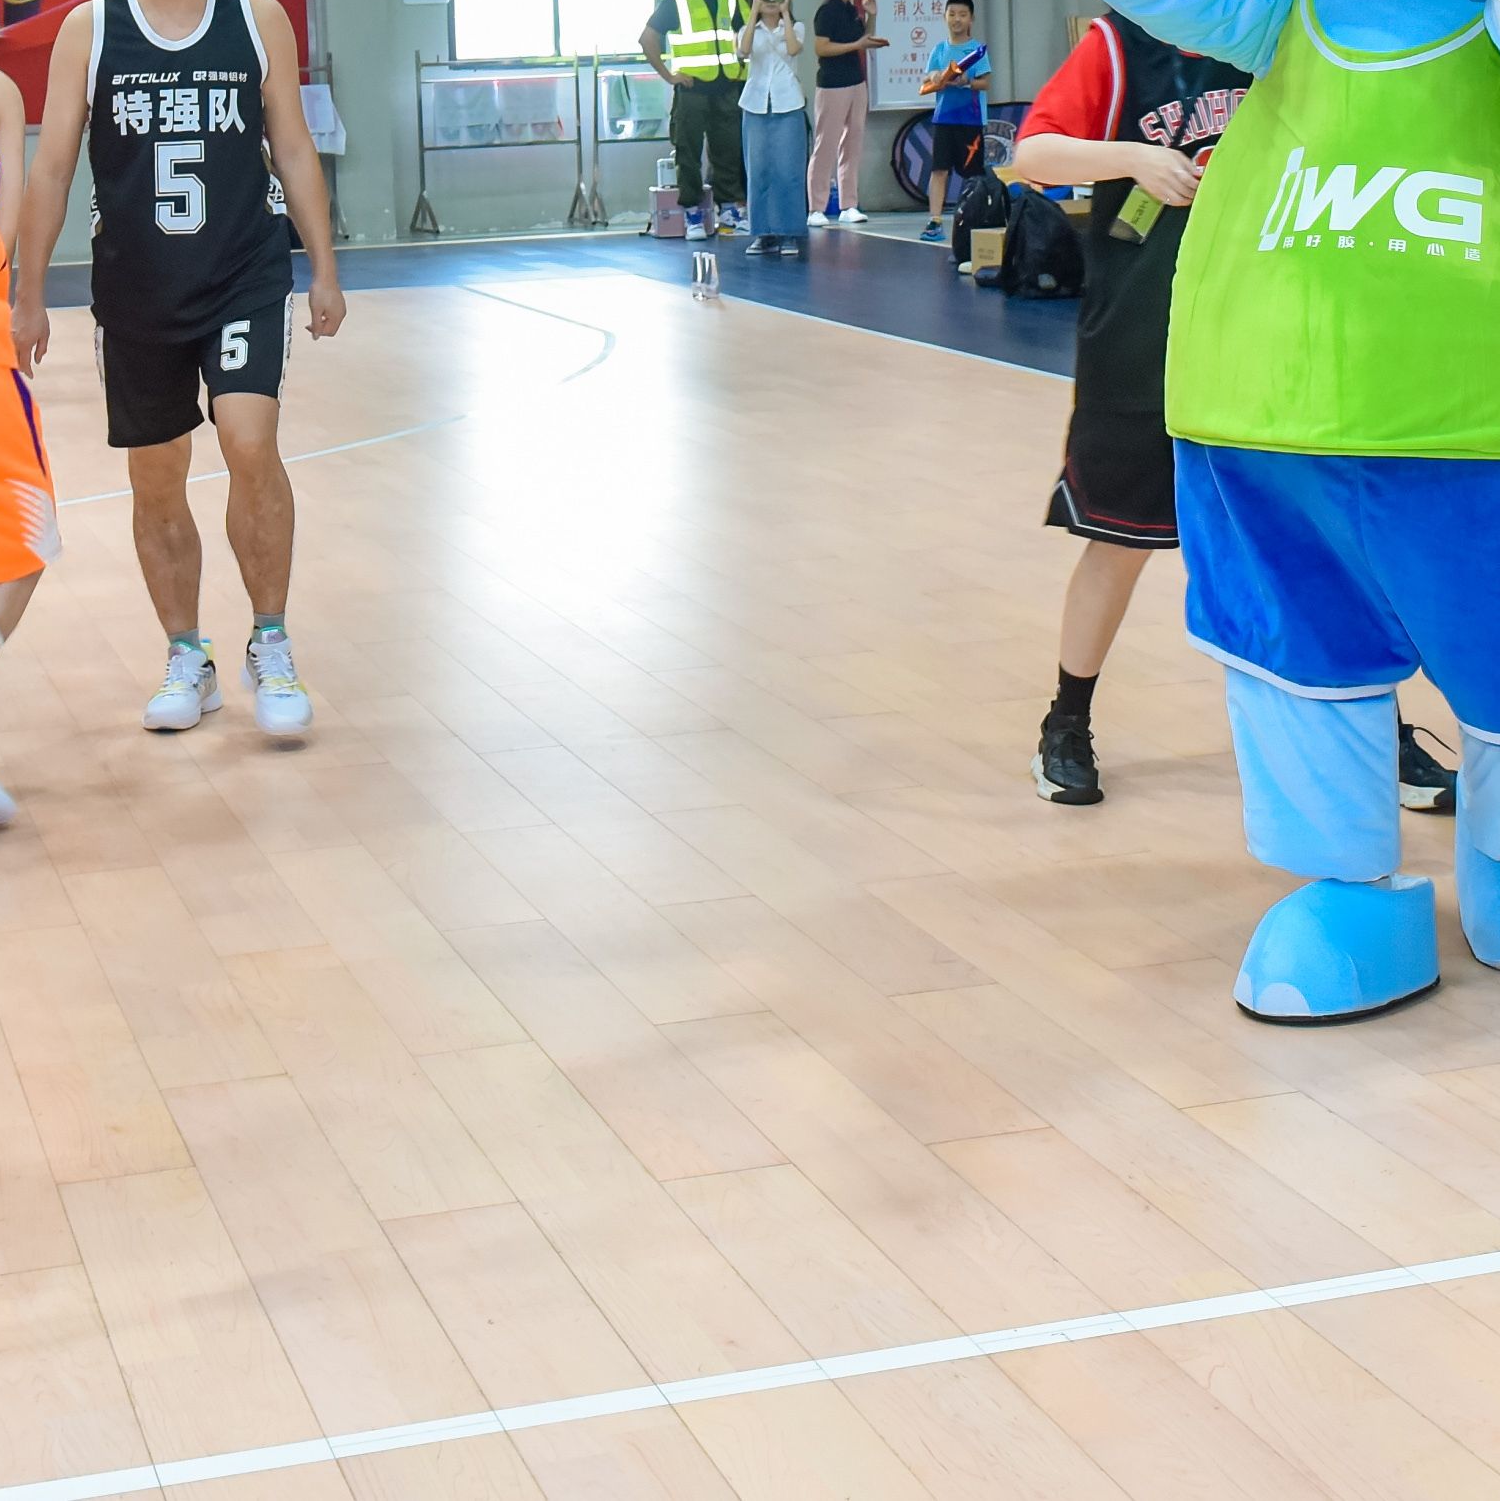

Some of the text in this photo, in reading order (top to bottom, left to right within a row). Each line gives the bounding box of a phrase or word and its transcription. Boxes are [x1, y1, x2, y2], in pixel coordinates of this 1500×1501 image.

[893, 0, 946, 17] 消火栓
[112, 88, 247, 136] 特强队
[154, 140, 206, 235] 5
[220, 320, 251, 372] 5
